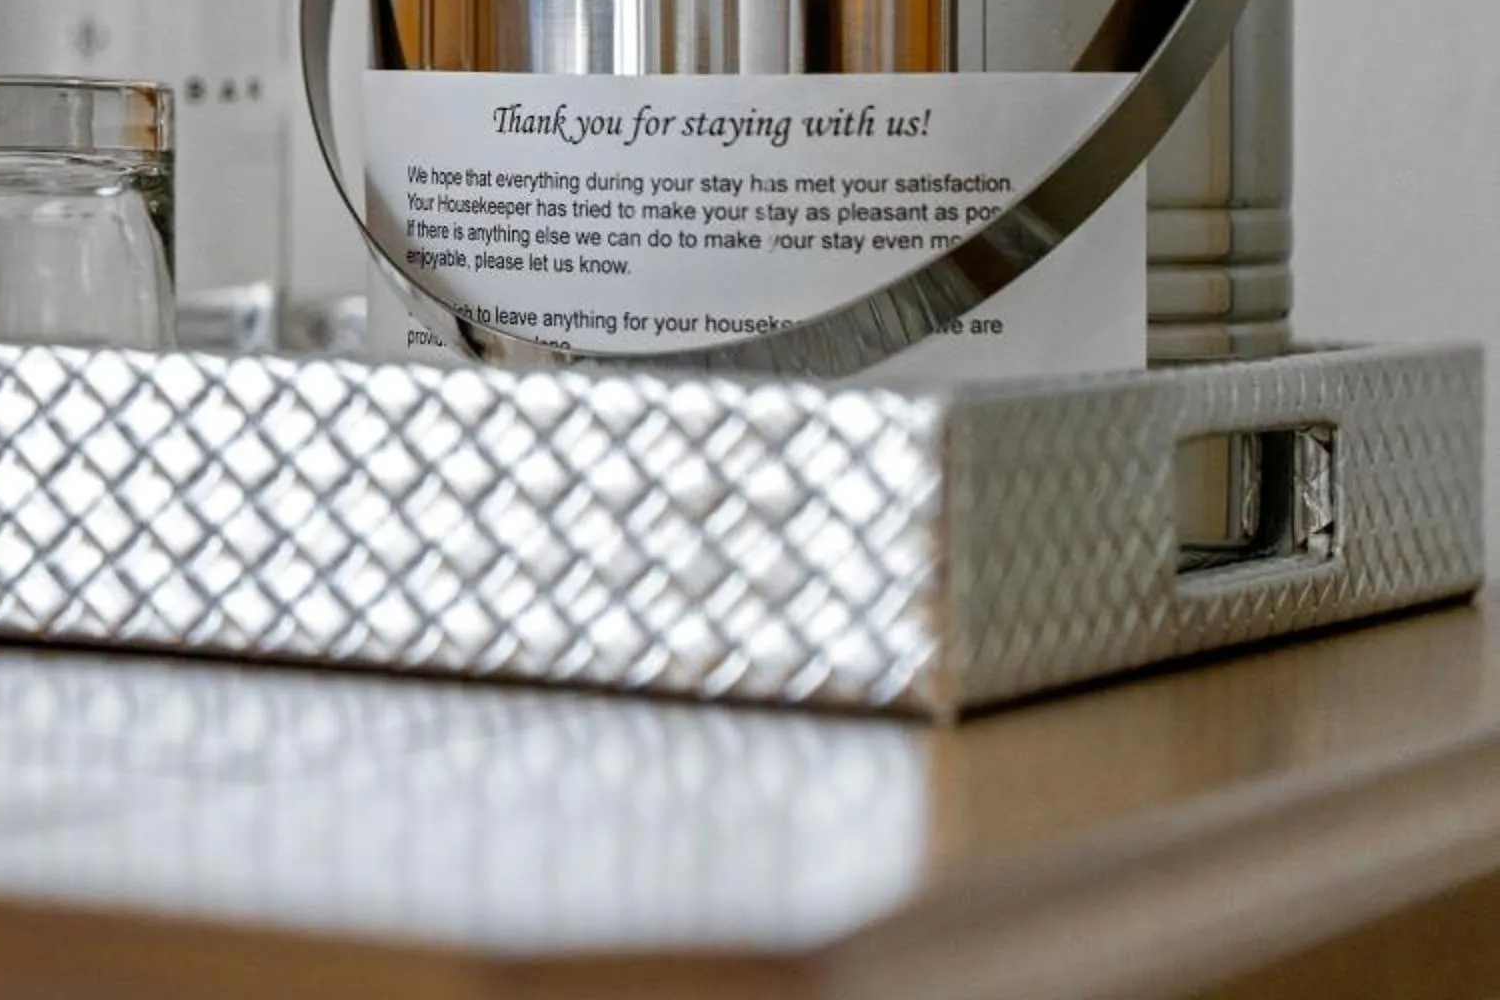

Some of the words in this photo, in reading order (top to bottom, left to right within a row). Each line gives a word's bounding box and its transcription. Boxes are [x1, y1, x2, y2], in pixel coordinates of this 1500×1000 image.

[494, 105, 573, 142] Thank
[570, 112, 621, 145] you
[624, 105, 676, 145] for
[682, 106, 791, 147] staying
[802, 105, 875, 137] with
[887, 109, 931, 137] us!
[408, 166, 428, 184] We
[431, 168, 462, 187] hope
[466, 169, 492, 187] that
[496, 170, 579, 192] everything
[586, 172, 644, 194] during
[650, 177, 694, 195] your
[701, 175, 742, 197] stay
[751, 174, 788, 192] has
[795, 176, 835, 193] met
[841, 178, 887, 197] your
[408, 193, 434, 211] Your
[438, 195, 530, 217] Housekeeper
[536, 199, 567, 217] has
[573, 200, 610, 219] tried
[618, 202, 634, 219] to
[642, 201, 696, 220] make
[702, 206, 748, 224] your
[755, 204, 798, 225] stay
[806, 207, 830, 221] as
[838, 203, 927, 225] pleasant
[934, 207, 958, 221] as
[408, 220, 416, 238] If
[417, 222, 449, 239] there
[453, 224, 464, 240] is
[468, 225, 530, 247] anything
[536, 228, 570, 244] else
[576, 232, 600, 246] we
[608, 232, 640, 247] can
[648, 230, 672, 248] do
[679, 231, 697, 248] to
[705, 232, 762, 249] make
[822, 232, 862, 253] stay
[872, 235, 924, 250] even
[407, 250, 470, 270] enjoyable,
[475, 252, 524, 272] please
[529, 254, 549, 271] let
[554, 260, 573, 272] us
[580, 256, 631, 275] know.
[477, 307, 491, 324] to
[495, 306, 537, 326] leave
[543, 308, 617, 332] anything
[624, 310, 648, 330] for
[654, 315, 698, 335] your
[970, 319, 1003, 334] are
